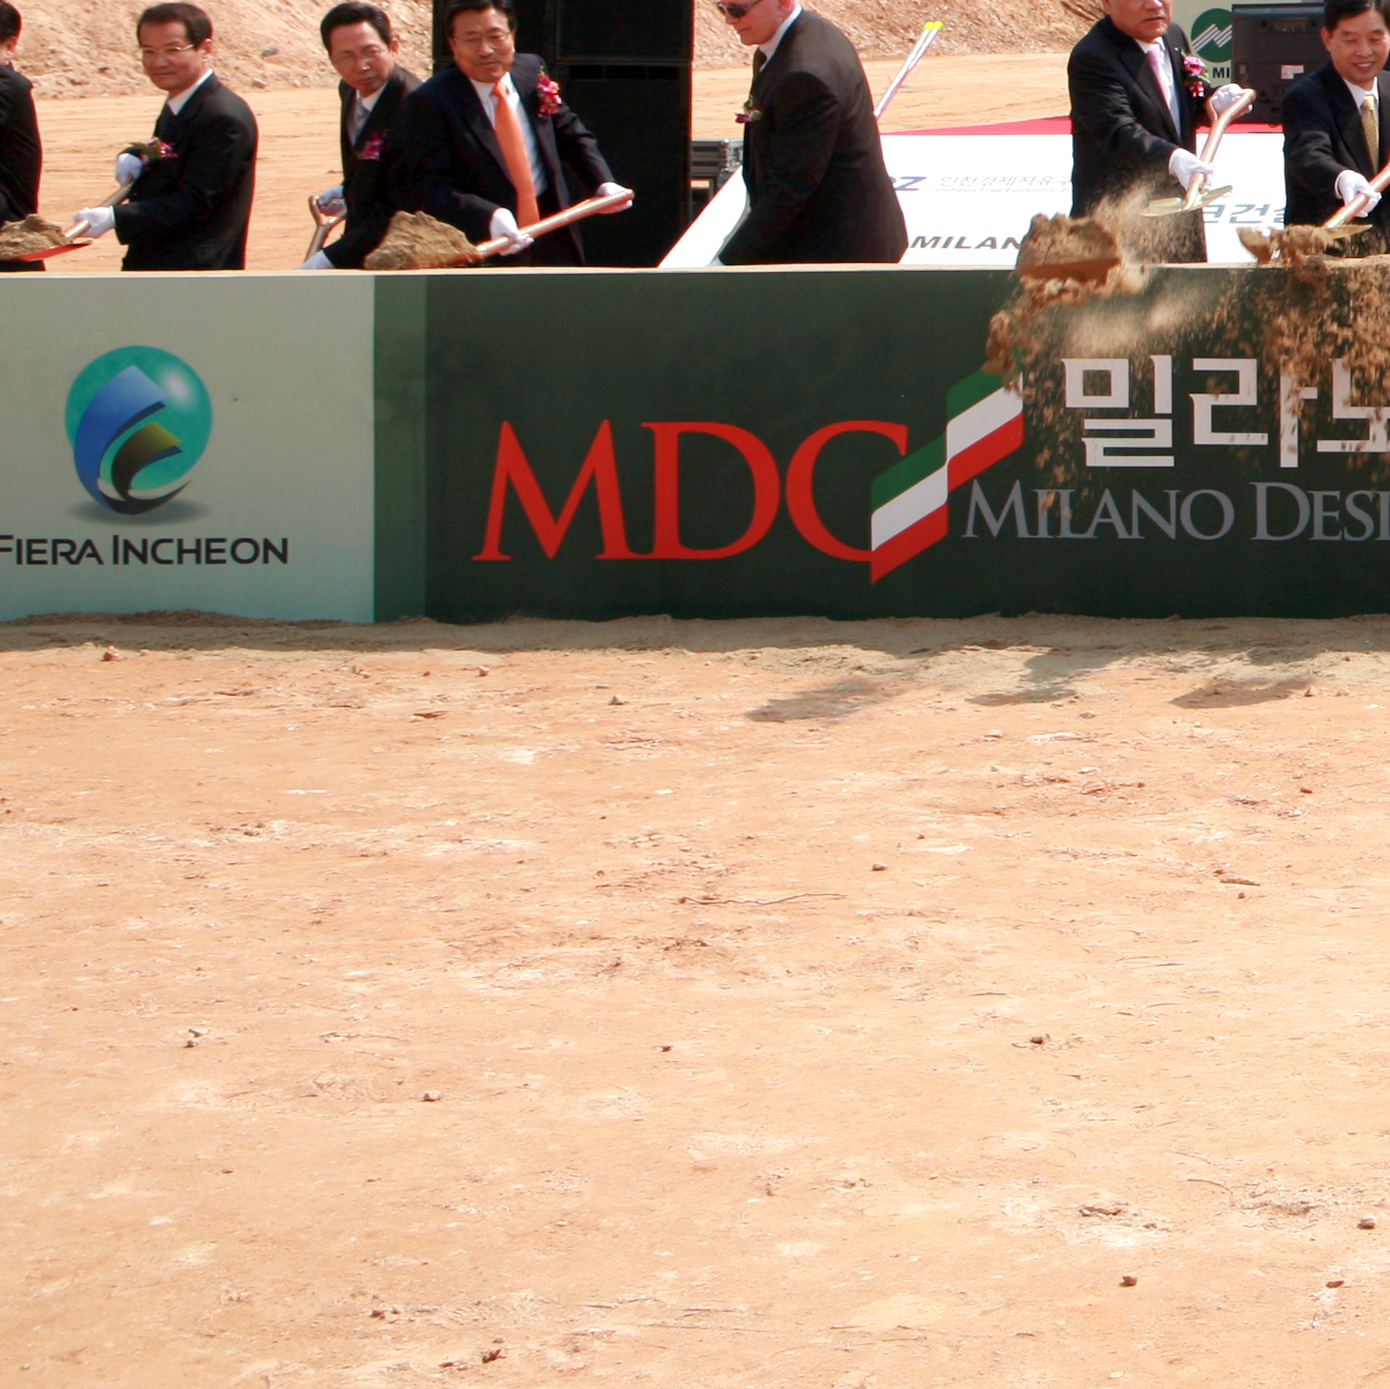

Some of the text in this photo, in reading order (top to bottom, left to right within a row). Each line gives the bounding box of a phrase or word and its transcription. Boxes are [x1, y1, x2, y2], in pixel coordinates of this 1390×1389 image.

[910, 235, 1022, 250] MILAN
[472, 418, 909, 563] MDC
[960, 479, 1235, 540] MILANO
[112, 534, 289, 565] INCHEON
